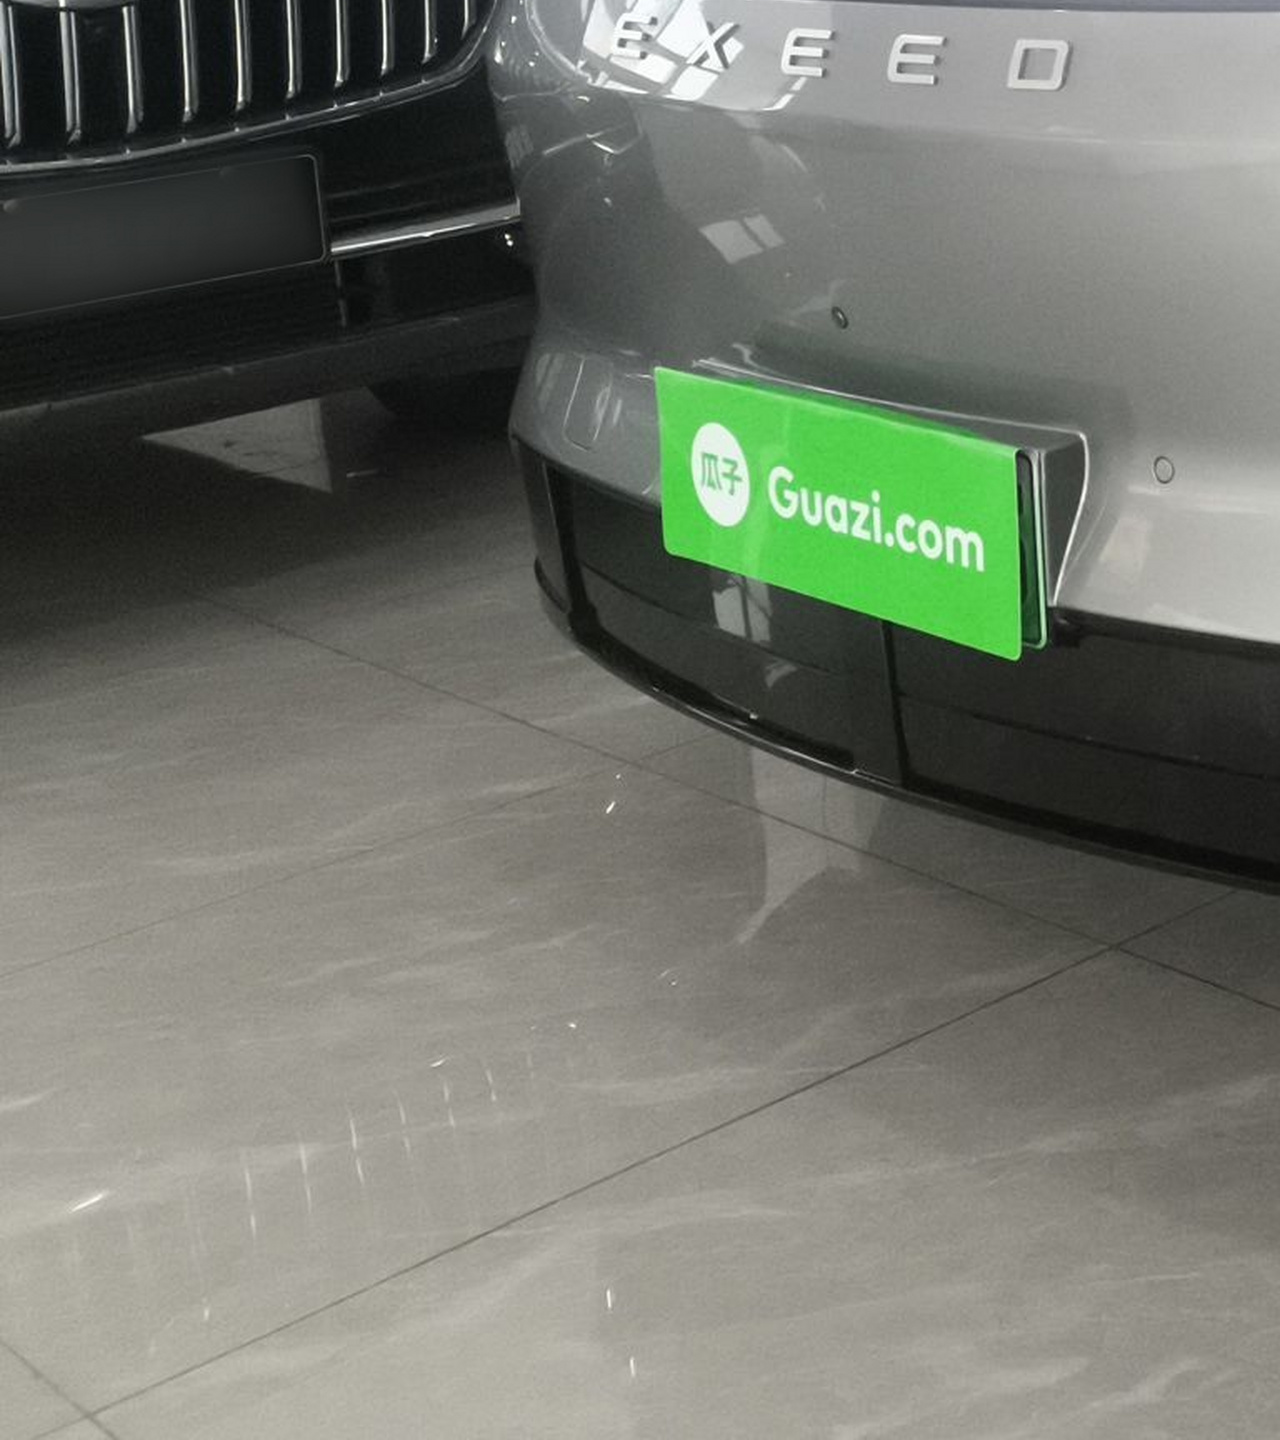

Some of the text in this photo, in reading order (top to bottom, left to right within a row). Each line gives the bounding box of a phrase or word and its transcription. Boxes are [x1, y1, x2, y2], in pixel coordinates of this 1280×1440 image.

[611, 13, 1071, 91] EXEED
[701, 452, 985, 573] 瓜子 Guazi.com
